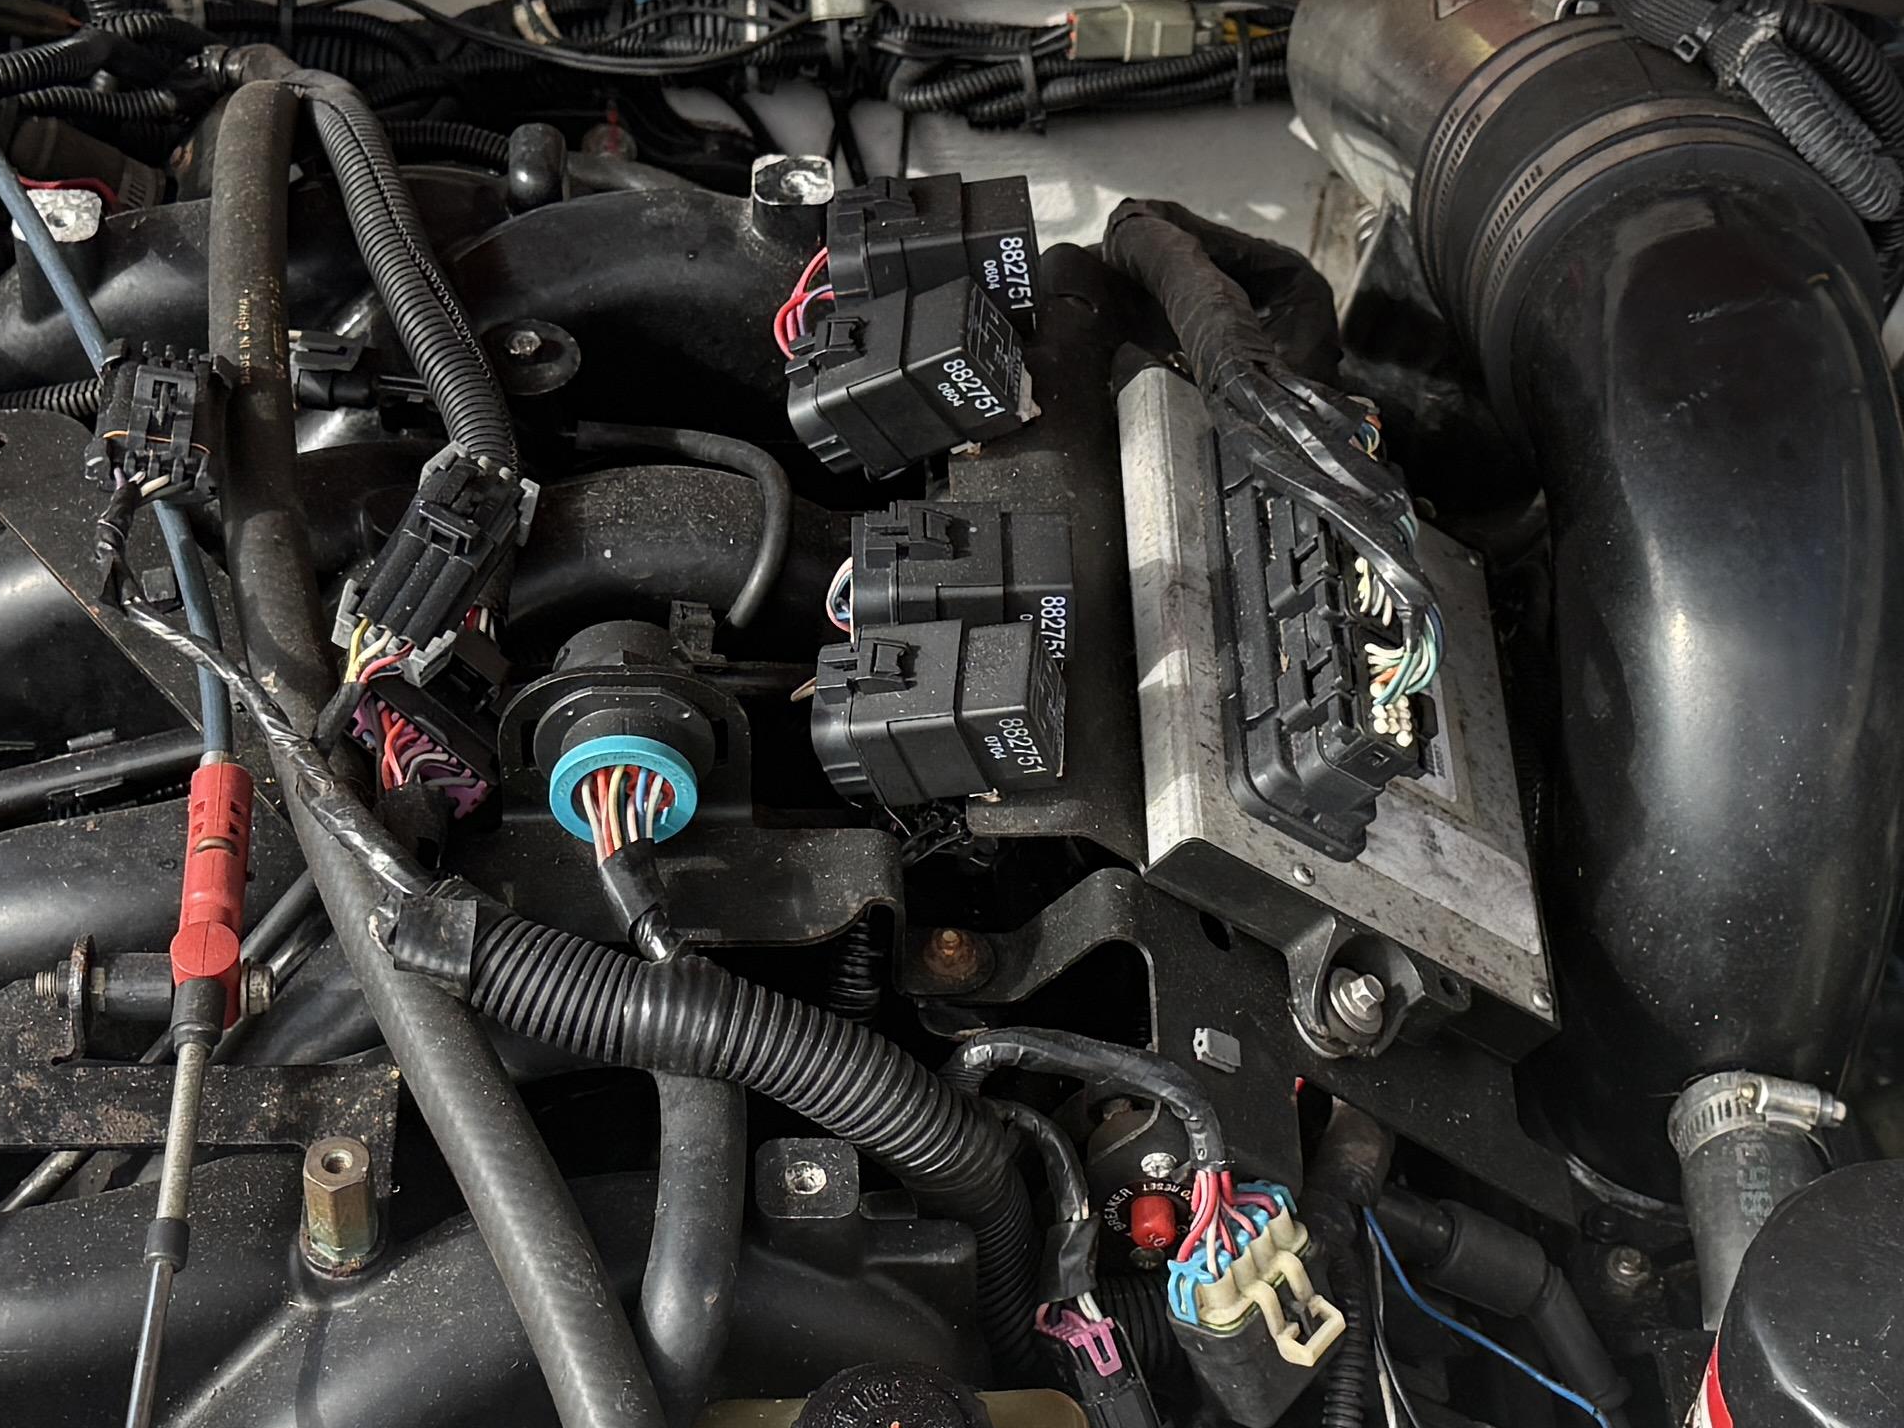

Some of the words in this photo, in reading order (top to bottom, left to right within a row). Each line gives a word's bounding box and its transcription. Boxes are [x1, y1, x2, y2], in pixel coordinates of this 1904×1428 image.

[999, 236, 1034, 312] 882751
[943, 358, 1007, 419] 882751
[1040, 595, 1066, 660] 882751
[984, 735, 1008, 760] 0704
[998, 717, 1048, 776] 882751
[1142, 1182, 1181, 1193] RESET
